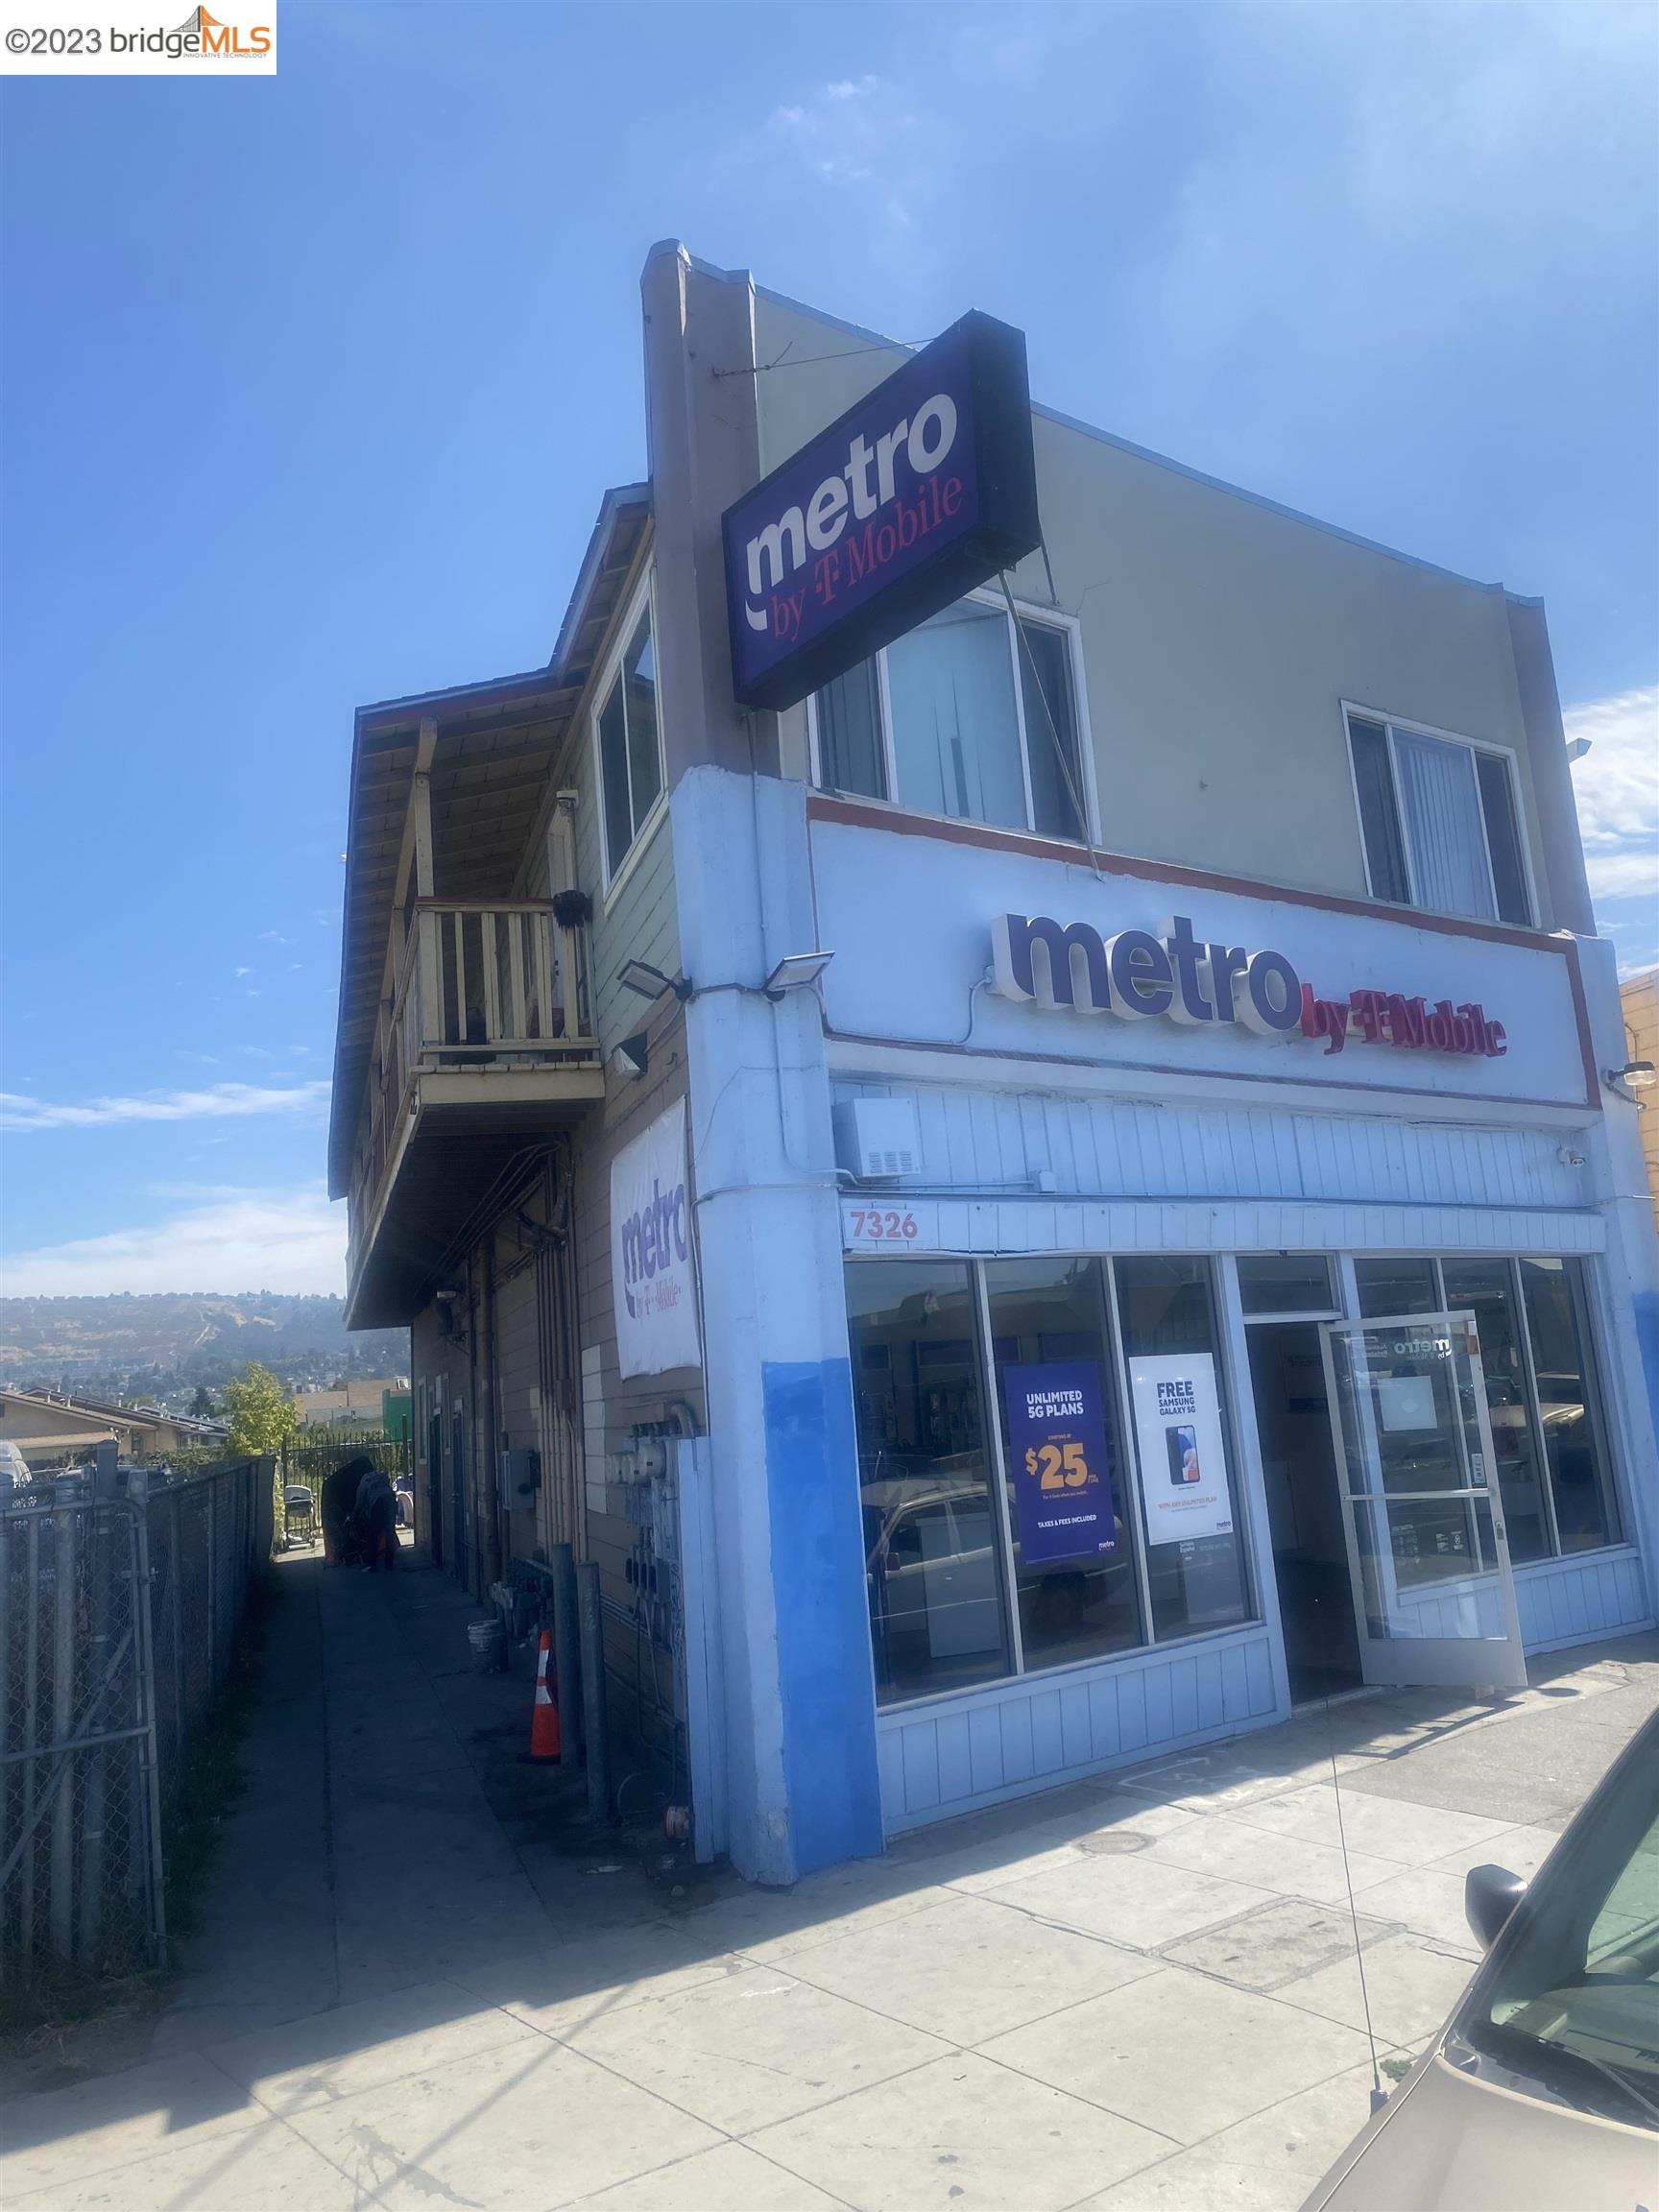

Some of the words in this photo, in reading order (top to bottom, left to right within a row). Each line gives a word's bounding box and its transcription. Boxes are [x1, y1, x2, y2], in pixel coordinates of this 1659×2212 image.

[746, 393, 958, 631] metro
[770, 584, 805, 642] by
[991, 913, 1304, 1034] metro
[1301, 983, 1351, 1055] by
[850, 1212, 919, 1238] 7326
[1026, 1390, 1083, 1405] UNLIMITED
[1157, 1381, 1193, 1398] FREE
[1028, 1406, 1045, 1419] 5G
[1046, 1402, 1084, 1417] PLANS
[1159, 1397, 1194, 1407] SAMSUNG
[1160, 1406, 1186, 1416] GALAXY
[1025, 1443, 1088, 1490] $25
[1038, 1520, 1054, 1528] TAXES
[1071, 1514, 1097, 1524] INCLUDED
[1098, 1540, 1115, 1551] metro
